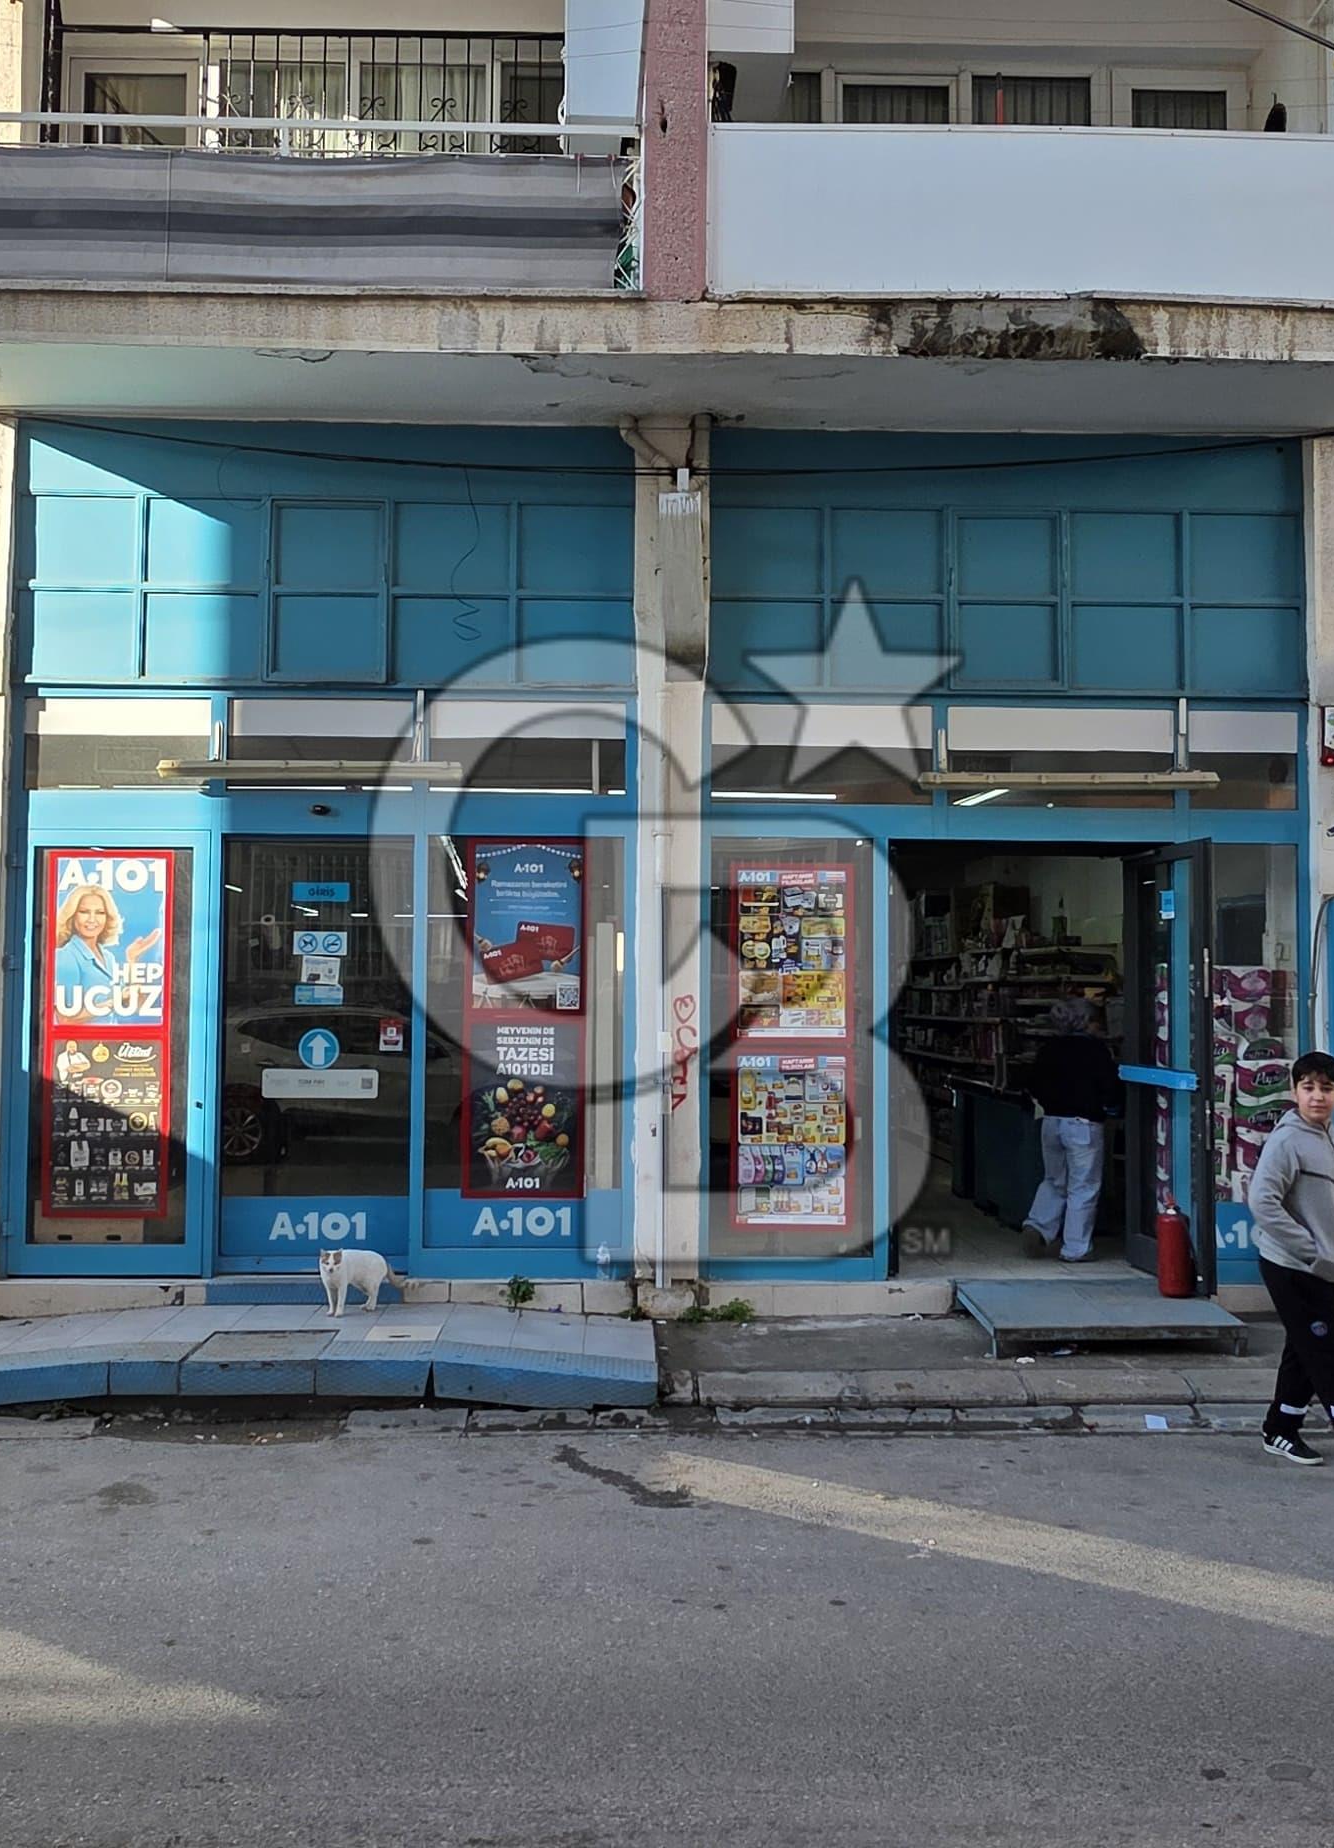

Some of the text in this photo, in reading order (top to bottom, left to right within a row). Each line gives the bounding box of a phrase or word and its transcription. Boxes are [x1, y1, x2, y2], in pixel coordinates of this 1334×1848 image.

[112, 963, 162, 984] HEP
[56, 985, 162, 1017] UCUZ
[543, 1027, 555, 1035] DE
[542, 1037, 555, 1045] DE
